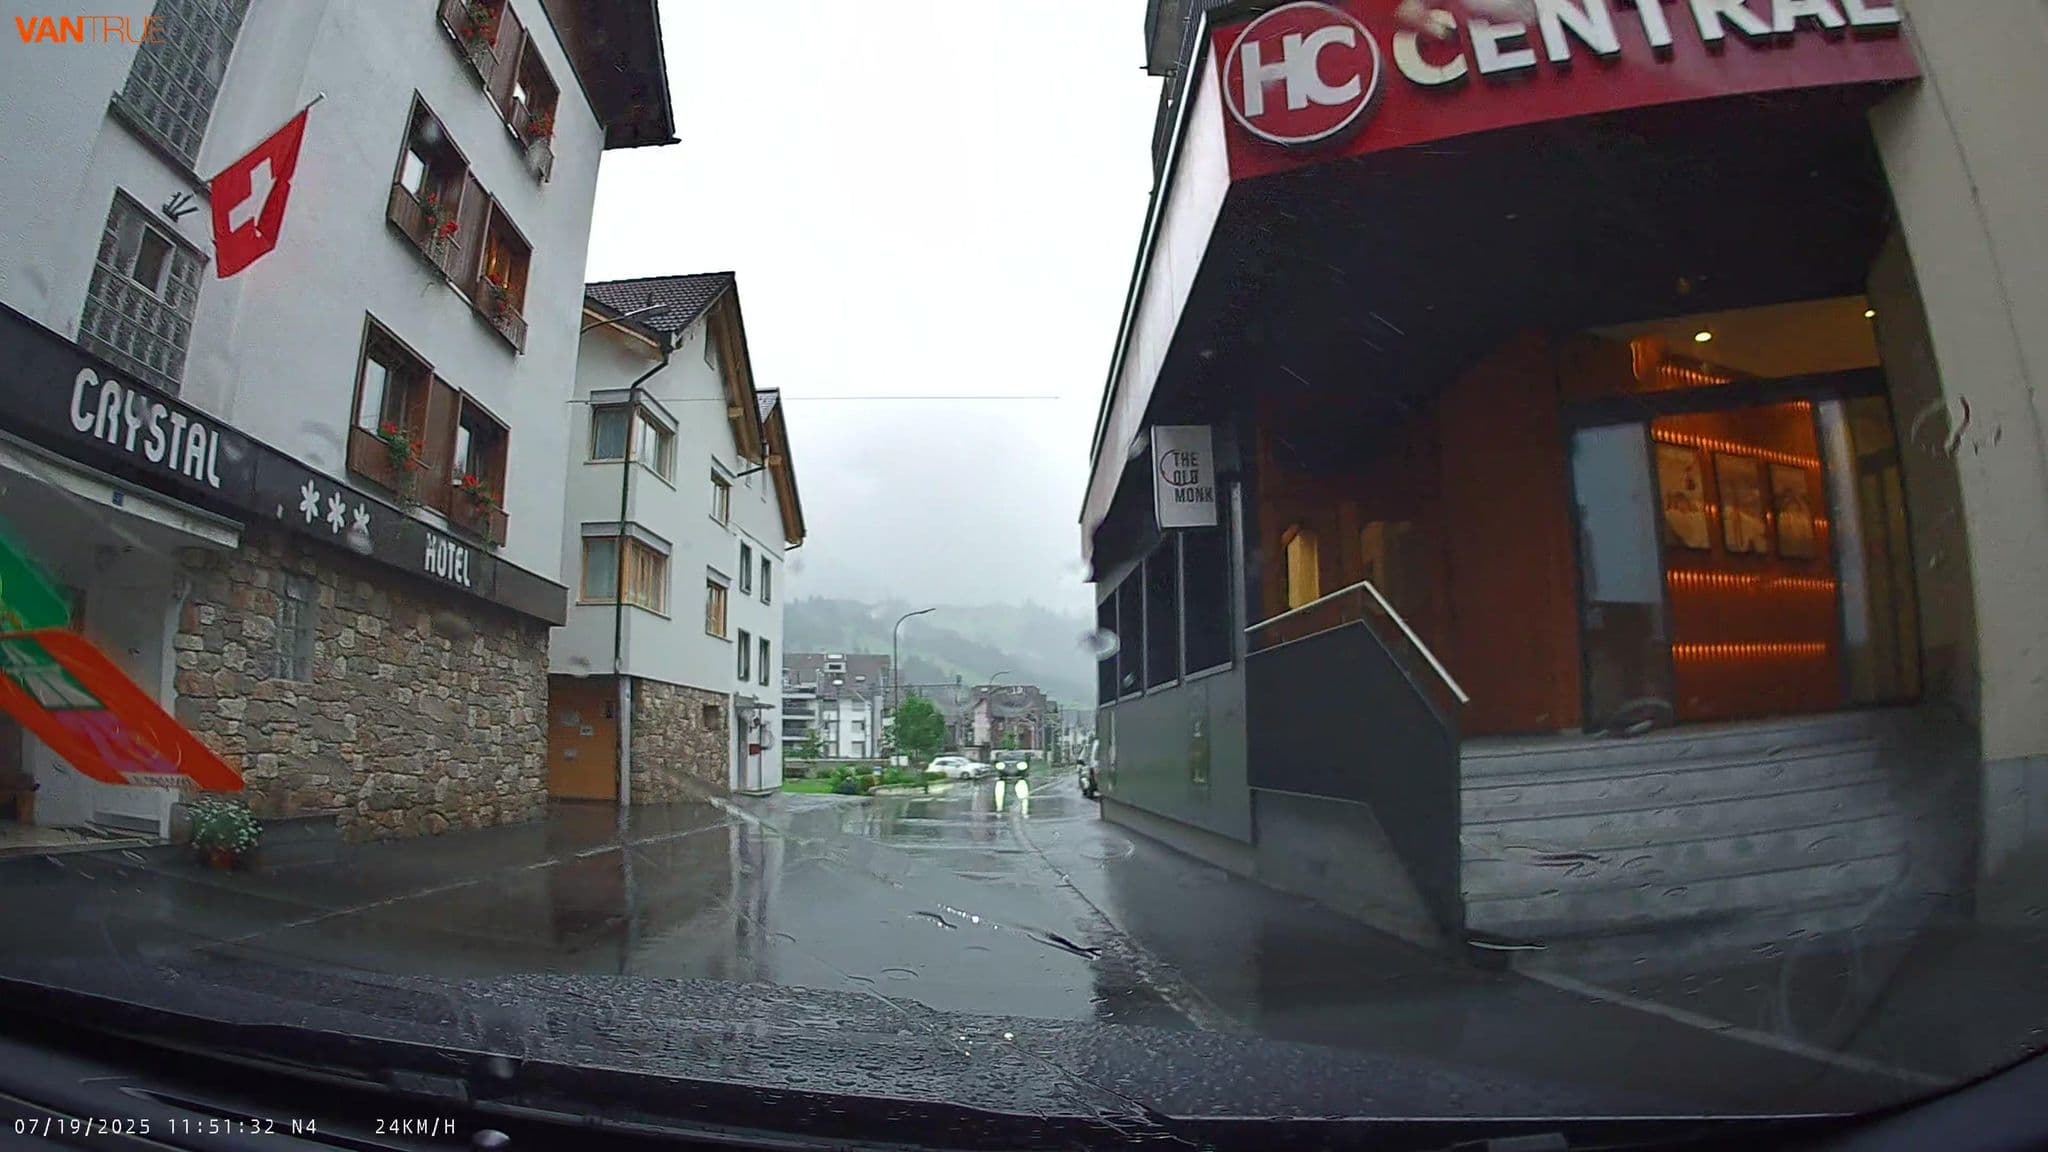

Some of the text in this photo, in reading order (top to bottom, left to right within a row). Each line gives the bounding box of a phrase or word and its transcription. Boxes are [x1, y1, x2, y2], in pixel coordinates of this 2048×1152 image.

[1241, 25, 1361, 118] HC
[70, 367, 221, 489] CRYSTAL
[1173, 451, 1199, 467] THE
[1173, 469, 1199, 485] OLD
[1175, 487, 1215, 504] MONK
[424, 532, 471, 588] HOTEL
